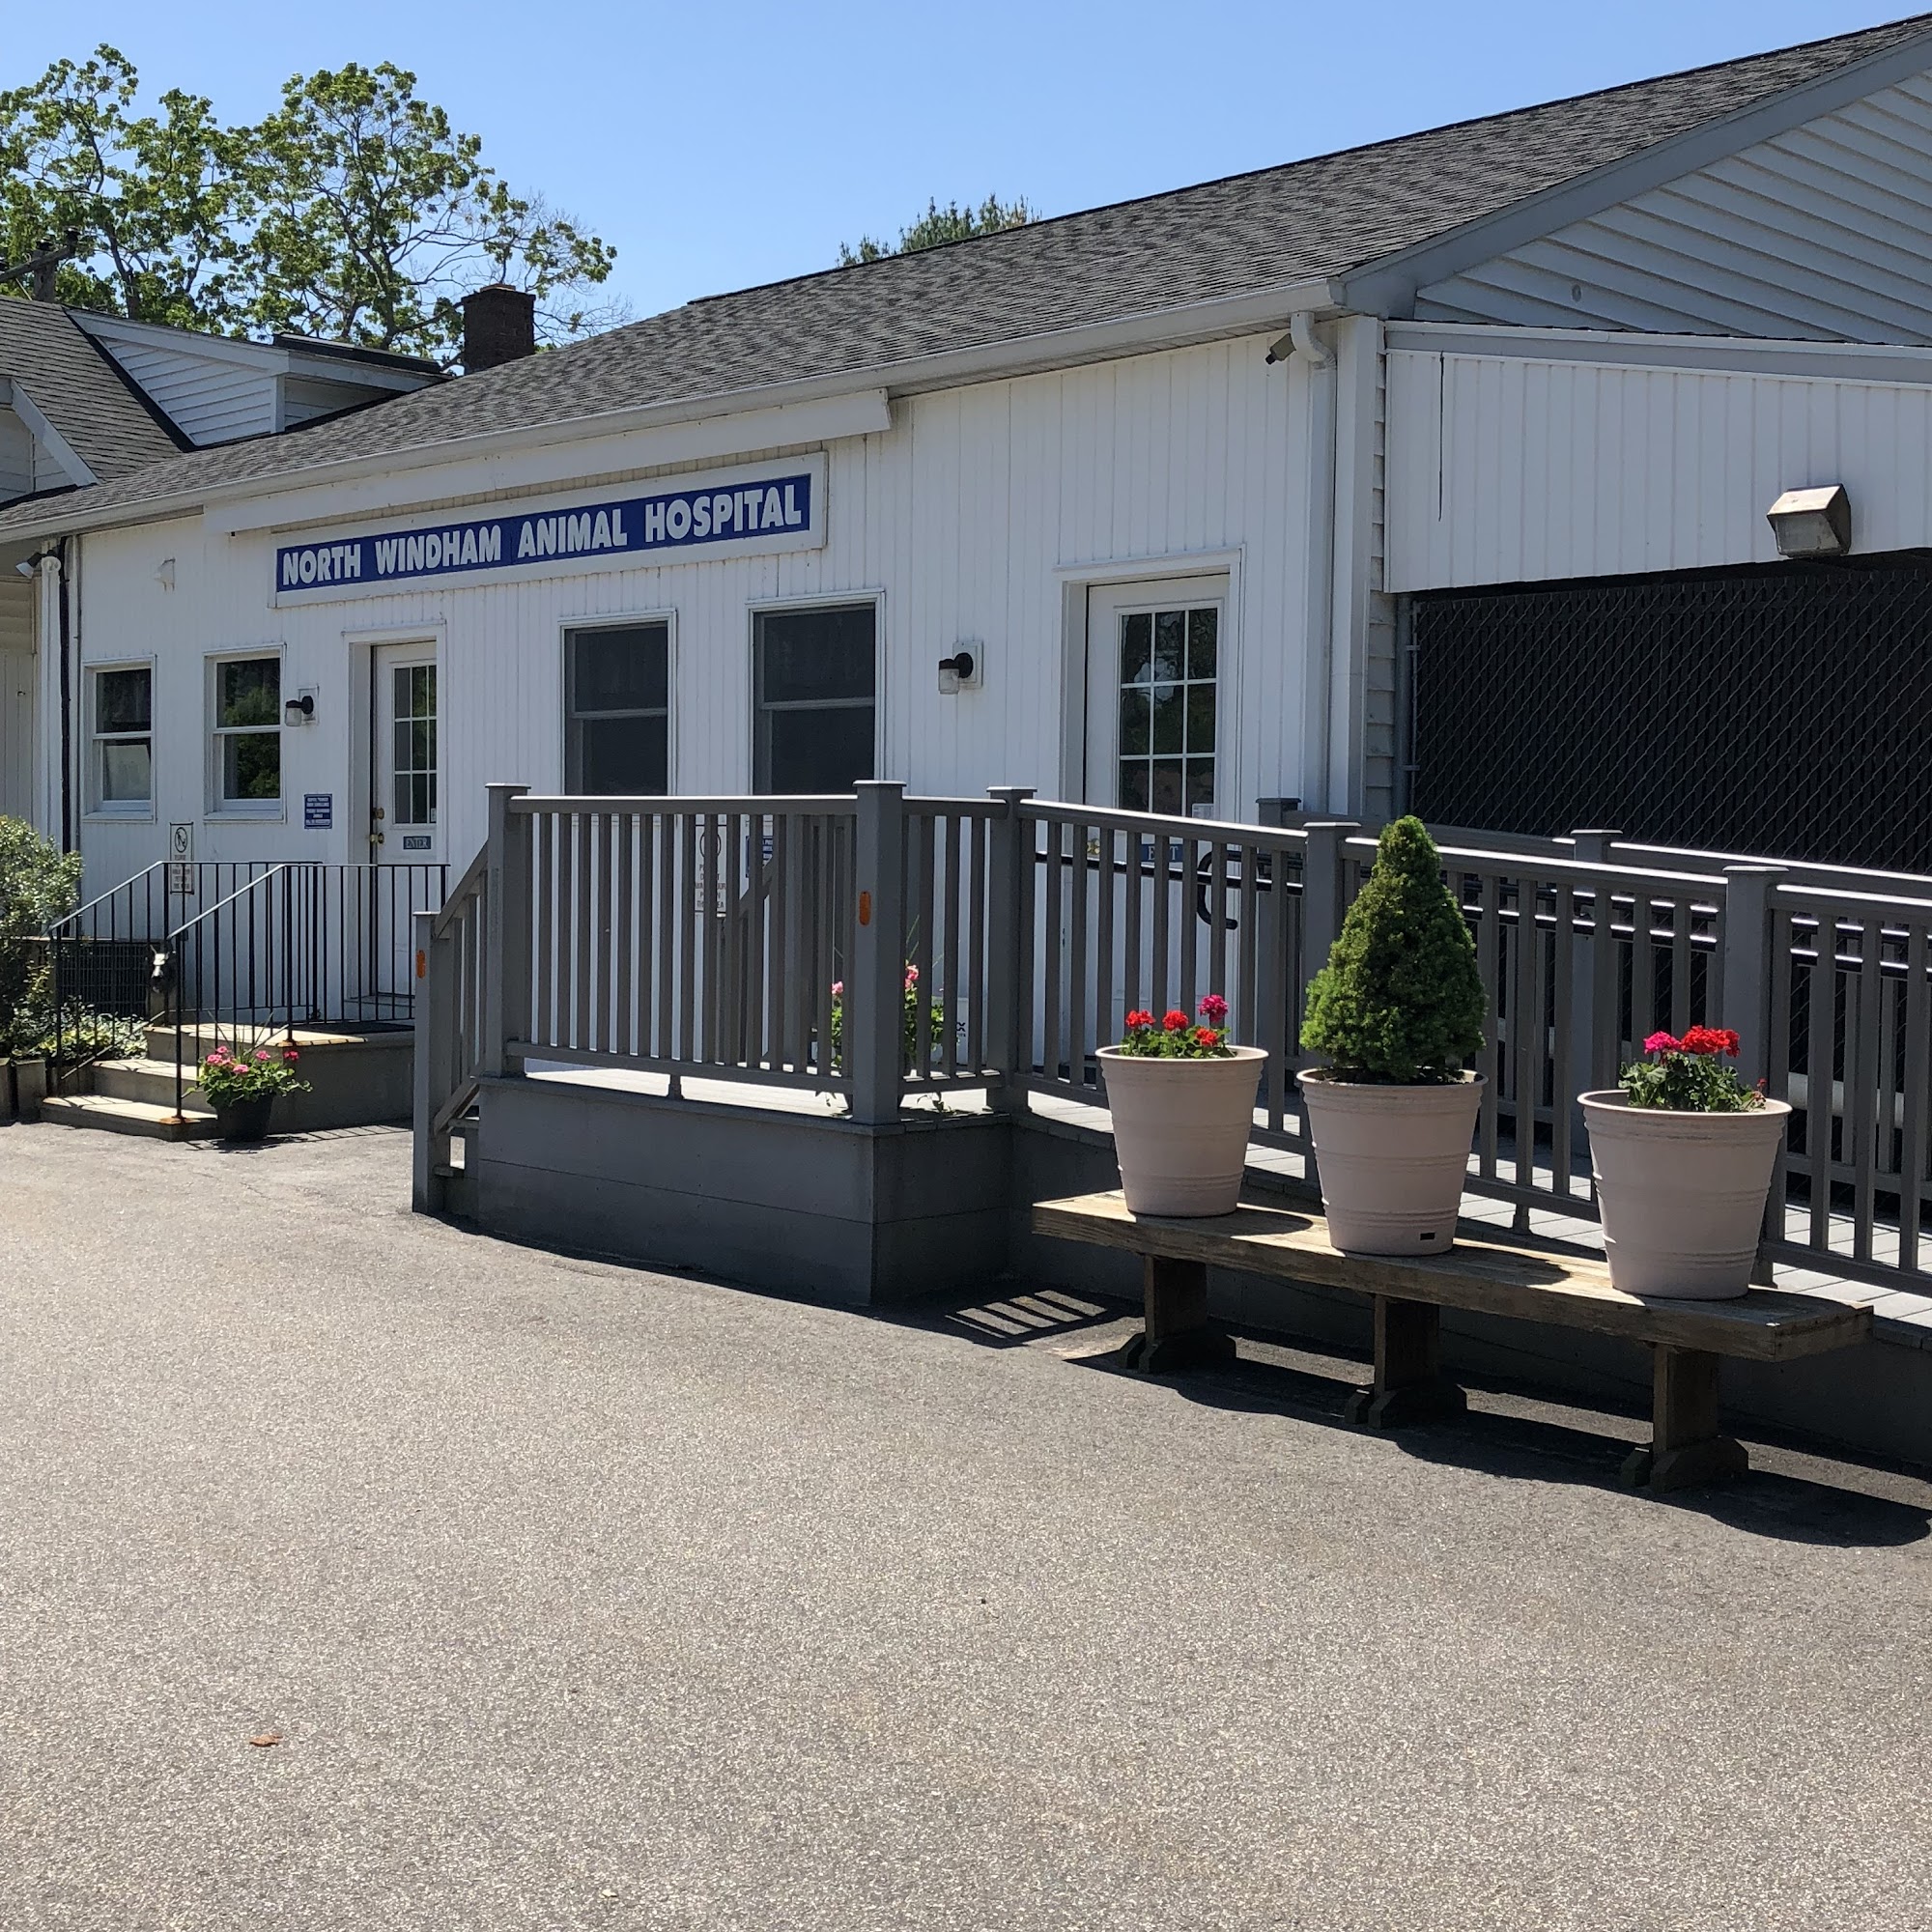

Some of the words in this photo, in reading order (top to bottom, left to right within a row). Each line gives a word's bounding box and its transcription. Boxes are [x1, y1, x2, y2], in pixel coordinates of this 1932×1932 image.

[283, 544, 361, 585] NORTH
[375, 525, 501, 575] WINDHAM
[517, 508, 628, 558] ANIMAL
[645, 484, 802, 543] HOSPITAL
[406, 837, 429, 849] ENTER
[1148, 845, 1179, 861] ET
